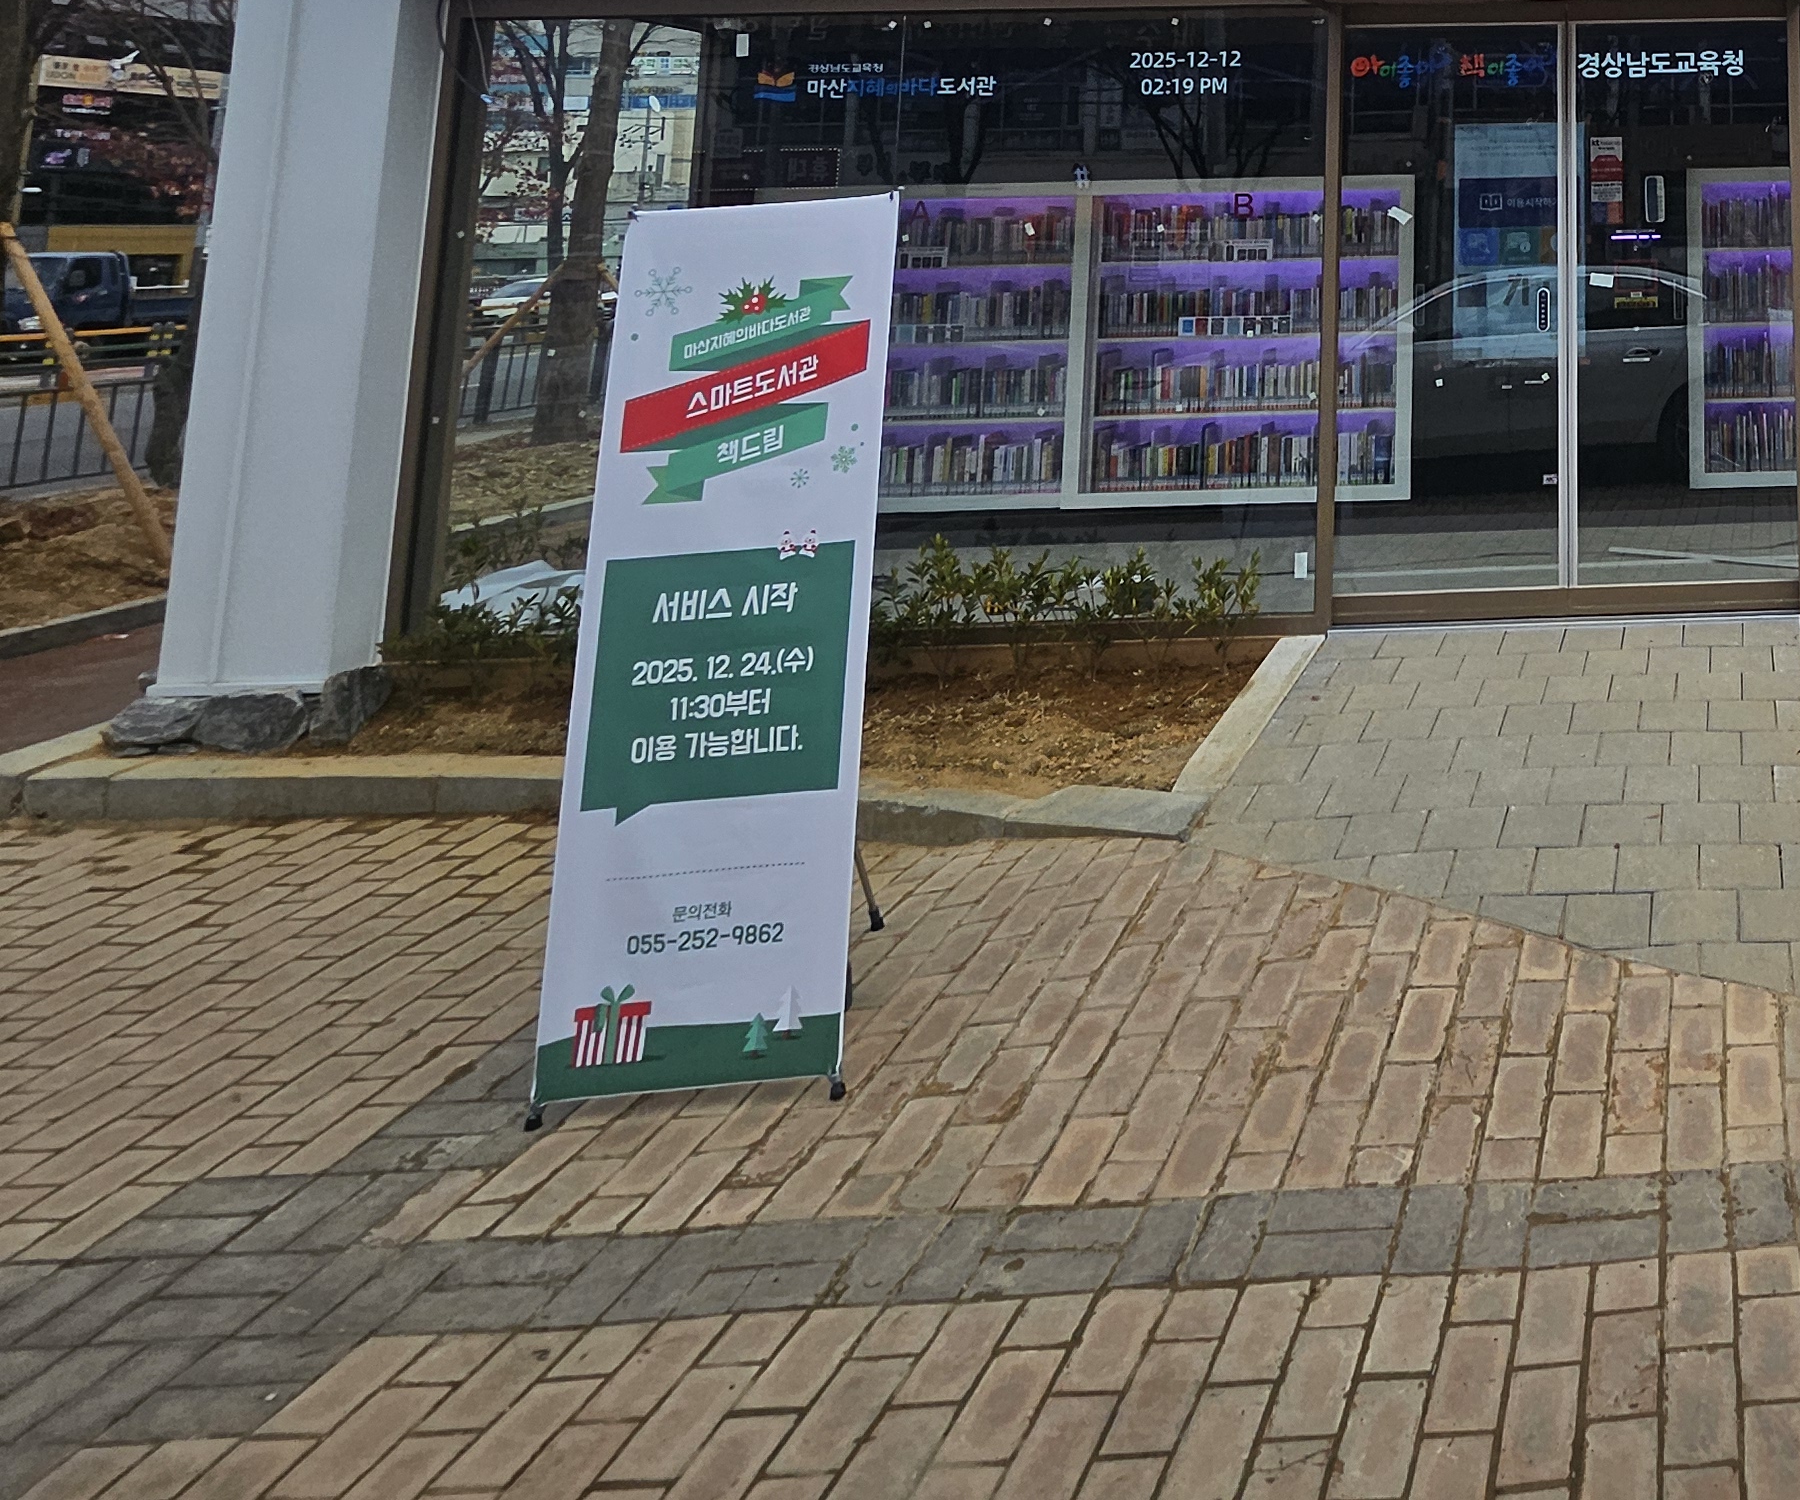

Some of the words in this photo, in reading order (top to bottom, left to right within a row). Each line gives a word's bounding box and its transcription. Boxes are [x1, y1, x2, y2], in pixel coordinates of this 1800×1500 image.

[1129, 50, 1241, 69] 2025-12-12
[1577, 49, 1744, 79] 경상남도교육청
[1141, 78, 1194, 95] 02:19
[1200, 77, 1228, 95] PM
[1233, 193, 1254, 219] B
[683, 305, 811, 360] 마산지혜의바다도서관
[685, 354, 819, 419] 스마트도서관
[717, 424, 785, 464] 책드림
[652, 588, 733, 624] 서비스
[741, 582, 799, 617] 시작
[631, 657, 698, 687] 2025.
[706, 654, 734, 680] 12.
[740, 646, 814, 677] 24.(수)
[670, 688, 771, 722] 11:30부터
[630, 733, 677, 764] 이용
[684, 724, 803, 759] 가능합니다.
[672, 901, 732, 924] 문의전화
[626, 921, 785, 956] 055-252-9862
